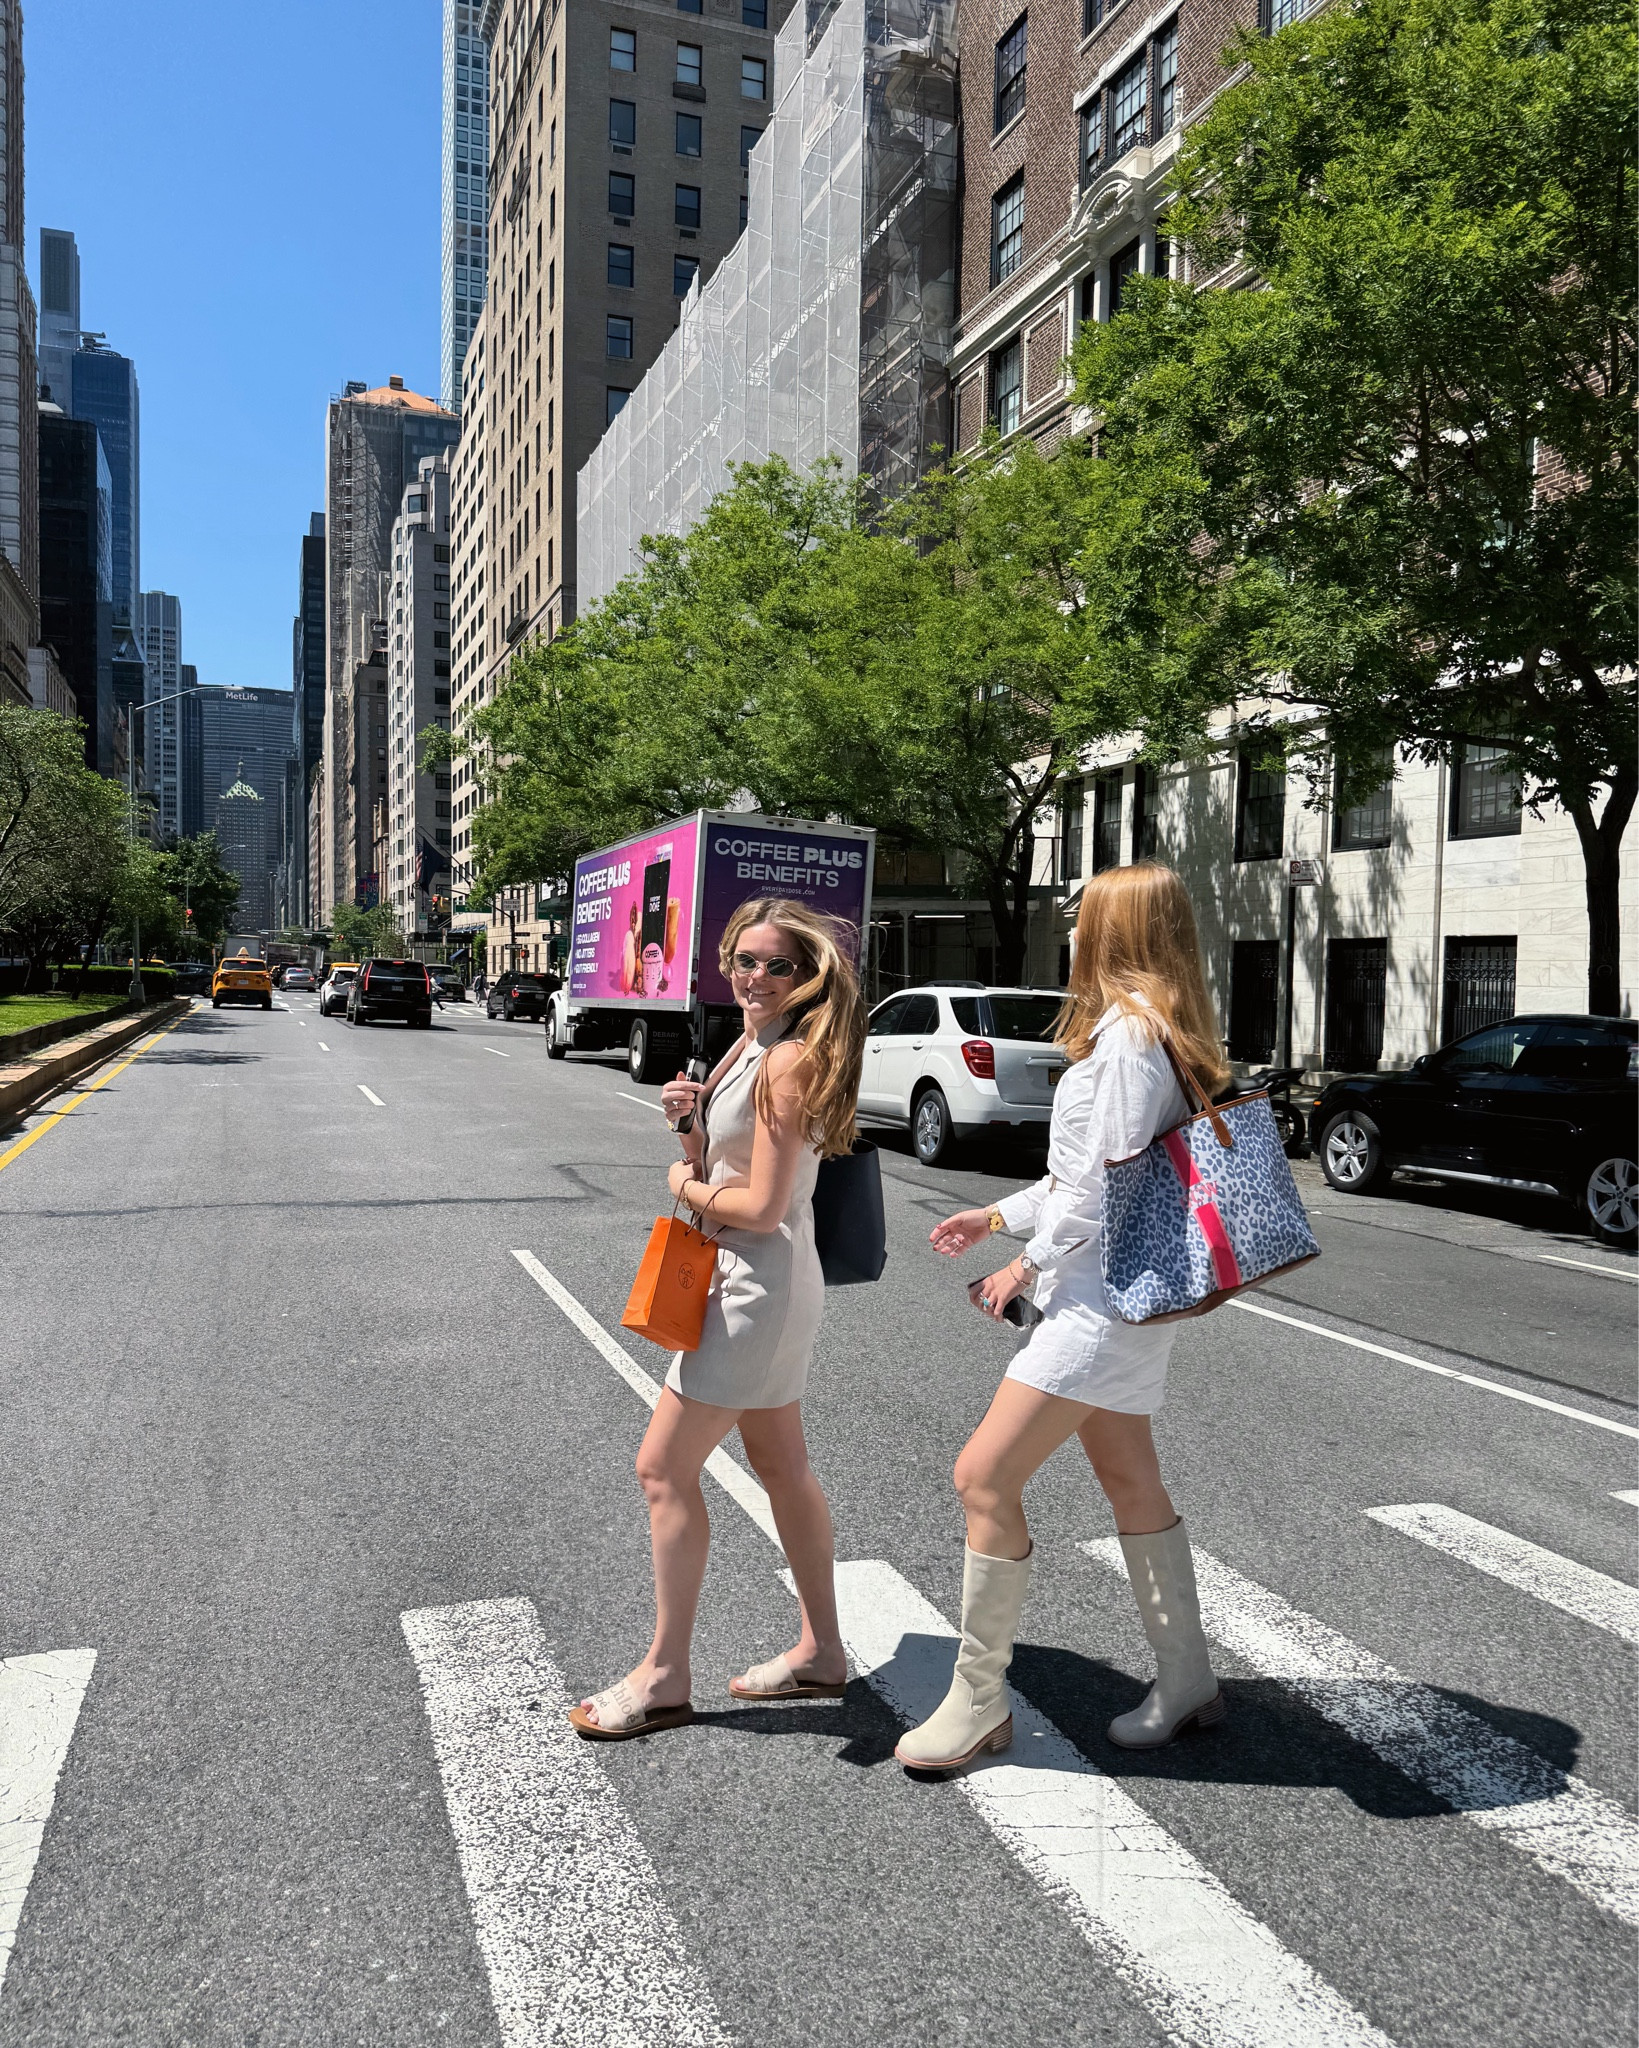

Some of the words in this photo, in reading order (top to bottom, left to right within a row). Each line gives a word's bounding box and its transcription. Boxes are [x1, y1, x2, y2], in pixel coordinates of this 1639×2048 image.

[225, 691, 259, 701] MetLife
[714, 838, 800, 862] COFFEE
[803, 847, 863, 869] PLUS
[578, 868, 608, 898] COFFEE
[607, 860, 631, 890] PLUS
[736, 862, 840, 888] BENEFITS
[761, 885, 816, 896] EVERYDAYDOSE.COM
[576, 896, 612, 925] BENEFITS
[610, 1680, 640, 1726] Chloé
